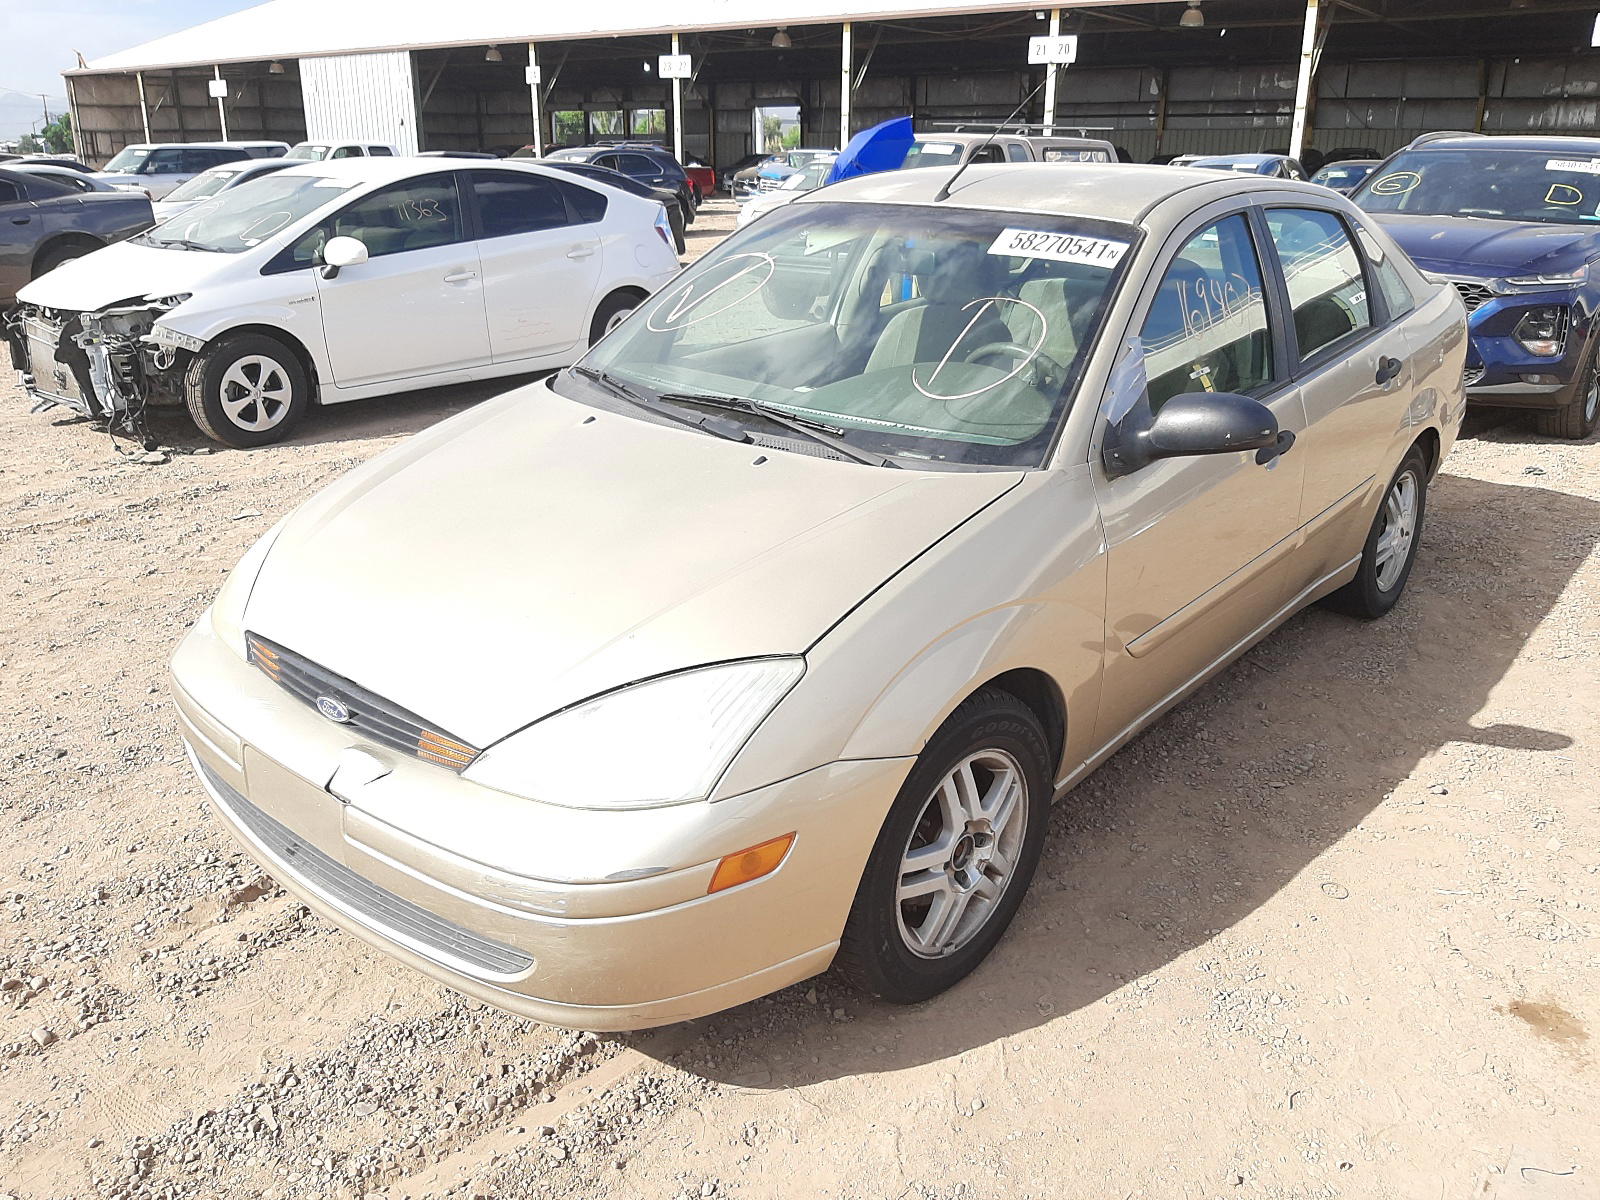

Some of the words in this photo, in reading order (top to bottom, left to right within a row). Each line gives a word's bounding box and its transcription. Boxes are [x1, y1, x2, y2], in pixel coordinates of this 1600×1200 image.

[1036, 44, 1046, 56] 21
[1058, 43, 1070, 55] 20
[1544, 184, 1583, 205] D
